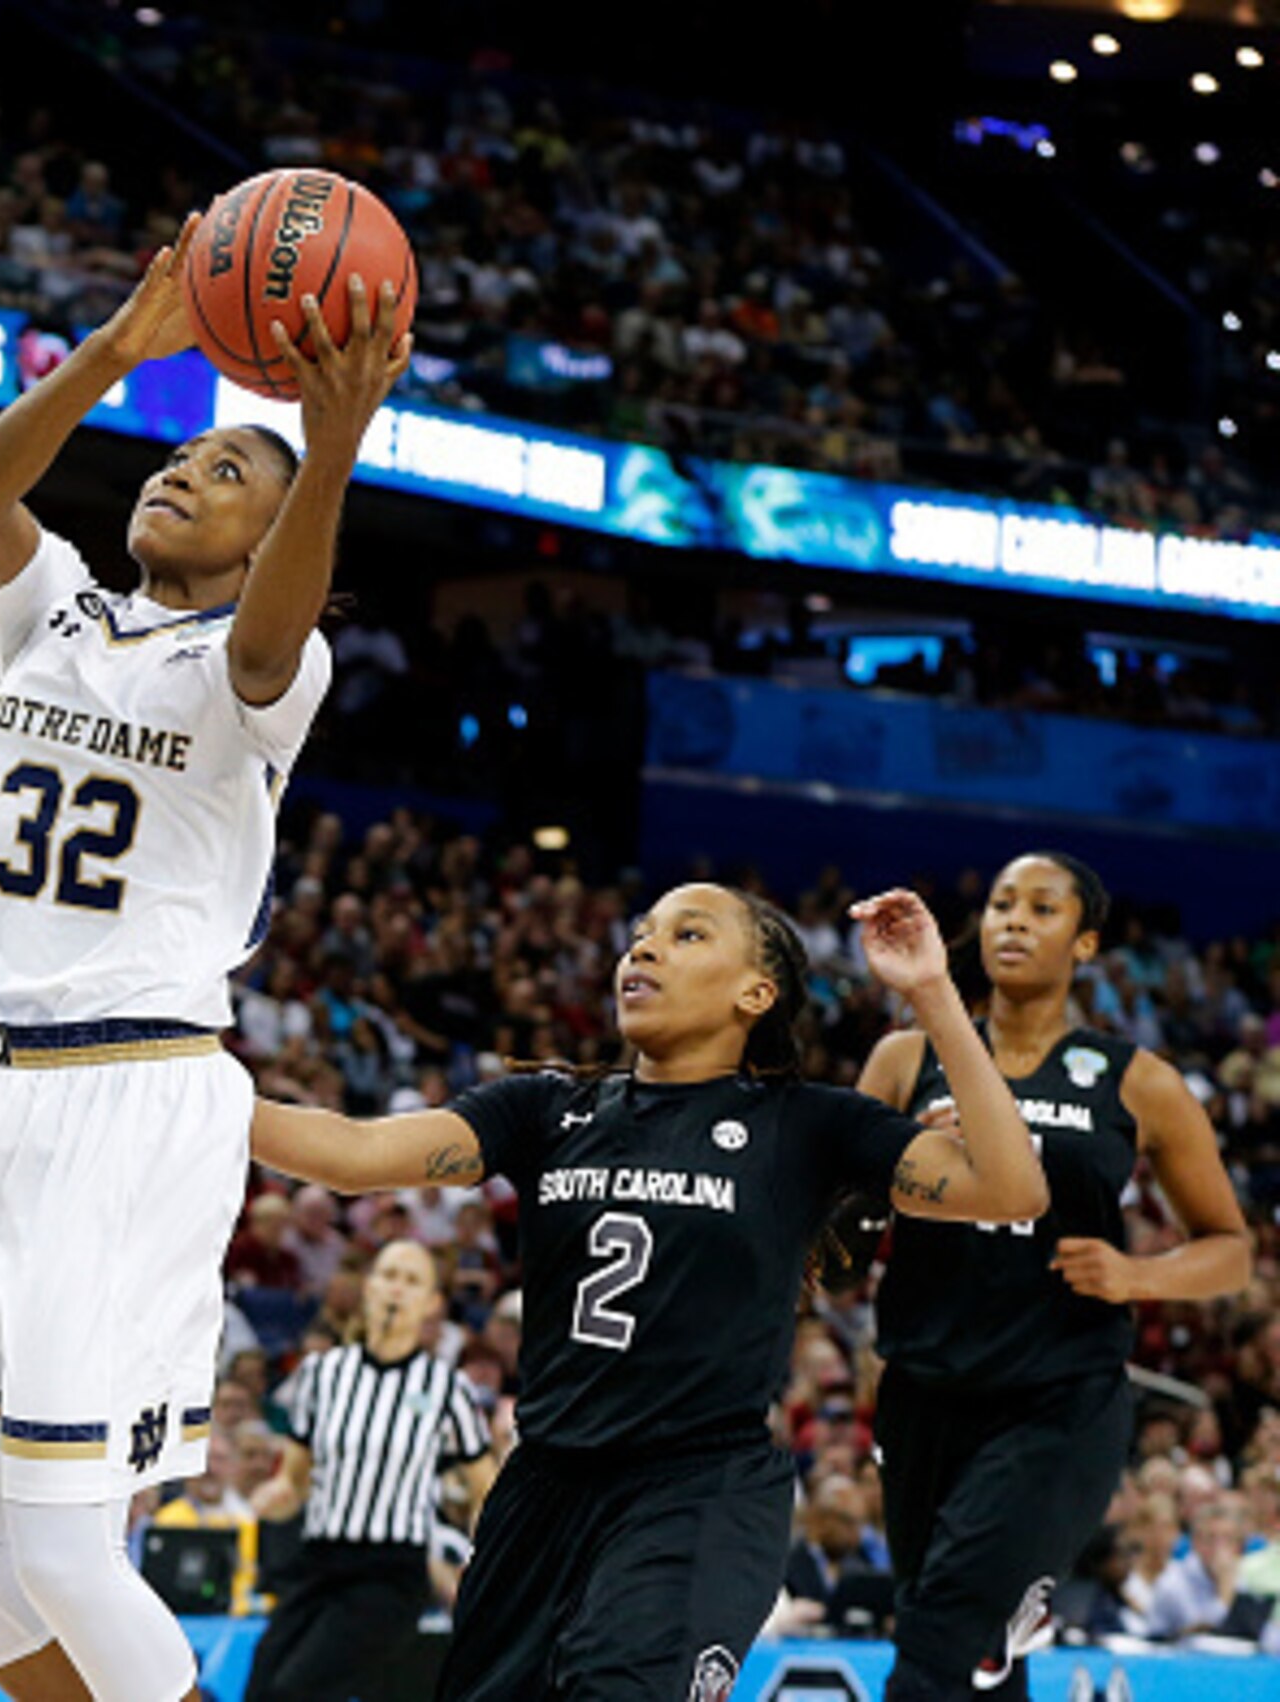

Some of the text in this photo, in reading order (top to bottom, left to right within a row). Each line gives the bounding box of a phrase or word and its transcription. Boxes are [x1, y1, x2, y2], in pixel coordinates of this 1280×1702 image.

[263, 174, 336, 301] Wilson
[86, 716, 193, 772] DAME
[1015, 1099, 1094, 1131] ROLINA
[538, 1168, 736, 1213] SOUTH CAROLINA
[570, 1210, 654, 1353] 2
